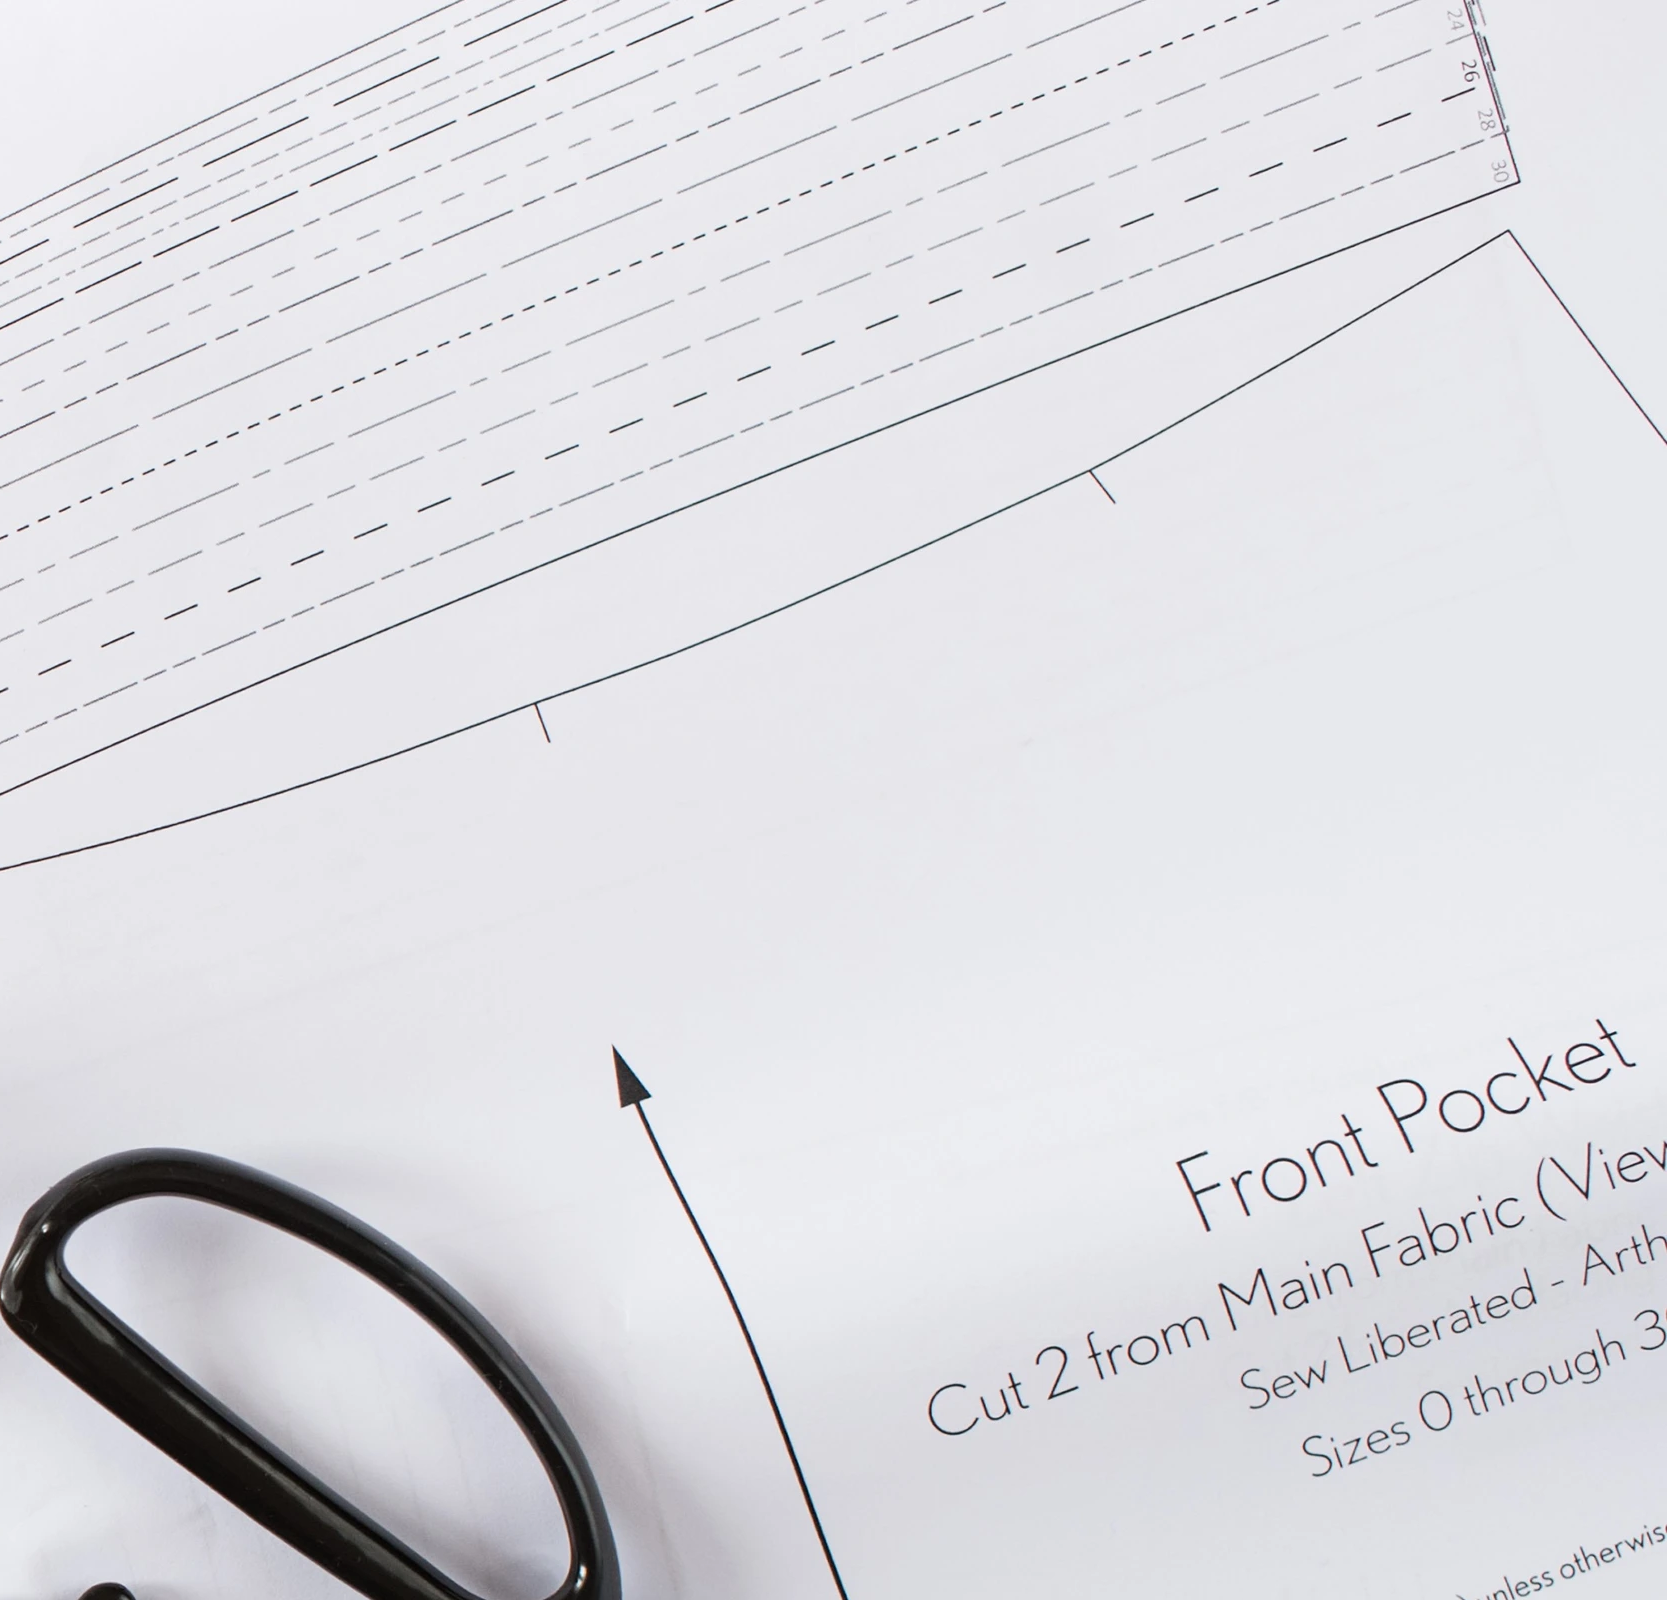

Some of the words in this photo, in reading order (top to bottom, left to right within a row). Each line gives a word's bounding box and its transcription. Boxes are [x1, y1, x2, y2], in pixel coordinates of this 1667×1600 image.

[1461, 59, 1480, 82] 26
[1477, 108, 1496, 132] 28
[1491, 159, 1510, 183] 30
[1176, 1114, 1379, 1232] Front
[1376, 1019, 1636, 1153] Pocket
[928, 1372, 1029, 1436] Cut
[1036, 1346, 1079, 1400] 2
[1087, 1316, 1210, 1380] from
[1218, 1260, 1353, 1331] Main
[1361, 1195, 1525, 1278] Fabric
[1241, 1360, 1327, 1409] Sew
[1337, 1267, 1537, 1373] Liberated
[1302, 1422, 1411, 1477] Sizes
[1464, 1329, 1626, 1416] through
[1560, 1525, 1667, 1579] otherwis
